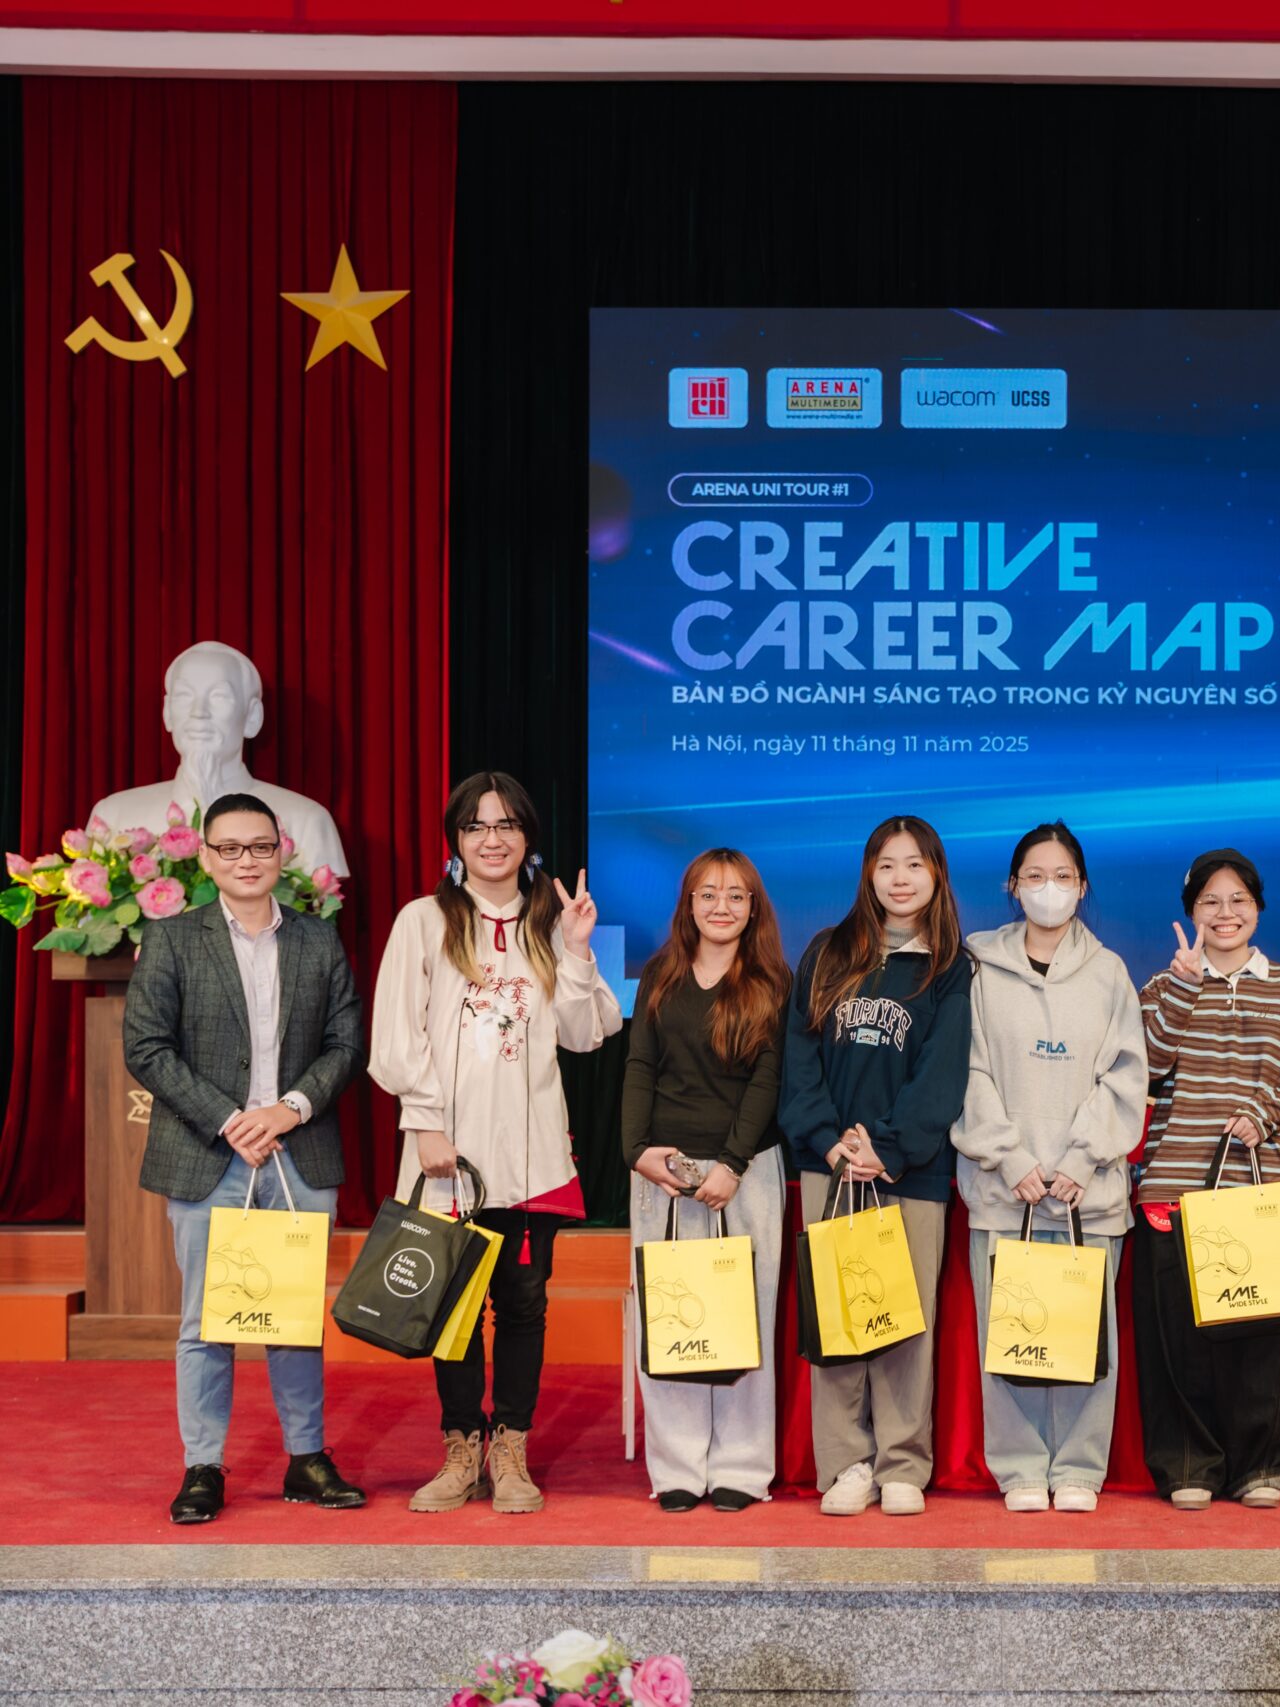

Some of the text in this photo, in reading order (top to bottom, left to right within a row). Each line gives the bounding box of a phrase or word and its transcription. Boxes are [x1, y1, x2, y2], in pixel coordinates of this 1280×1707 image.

[791, 382, 858, 393] ARENA
[791, 400, 858, 408] MULTIMEDIA
[916, 389, 1050, 407] wacom UCSS
[692, 482, 849, 496] ARENA UNI TOUR #1
[671, 520, 1098, 592] CREATIVE
[671, 600, 1274, 671] CAREER MAP
[672, 680, 1278, 708] BẢN ĐỒ NGÀNH SÁNG TẠO TRONG KỶ NGUYÊN SỐ
[672, 734, 1029, 757] Hà Nội, ngày 11 tháng 11 năm 2025
[1036, 1040, 1067, 1053] FILA
[401, 1220, 431, 1237] wacom
[398, 1254, 416, 1268] Live.
[393, 1263, 414, 1277] Dare.
[389, 1273, 418, 1289] Create.
[1217, 1285, 1259, 1303] AME
[1229, 1300, 1247, 1308] WIDE
[225, 1312, 272, 1326] AME
[865, 1312, 893, 1333] AME
[874, 1327, 887, 1338] WIDE
[666, 1340, 709, 1355] AME
[1004, 1344, 1048, 1360] AME
[1015, 1359, 1033, 1367] WIDE
